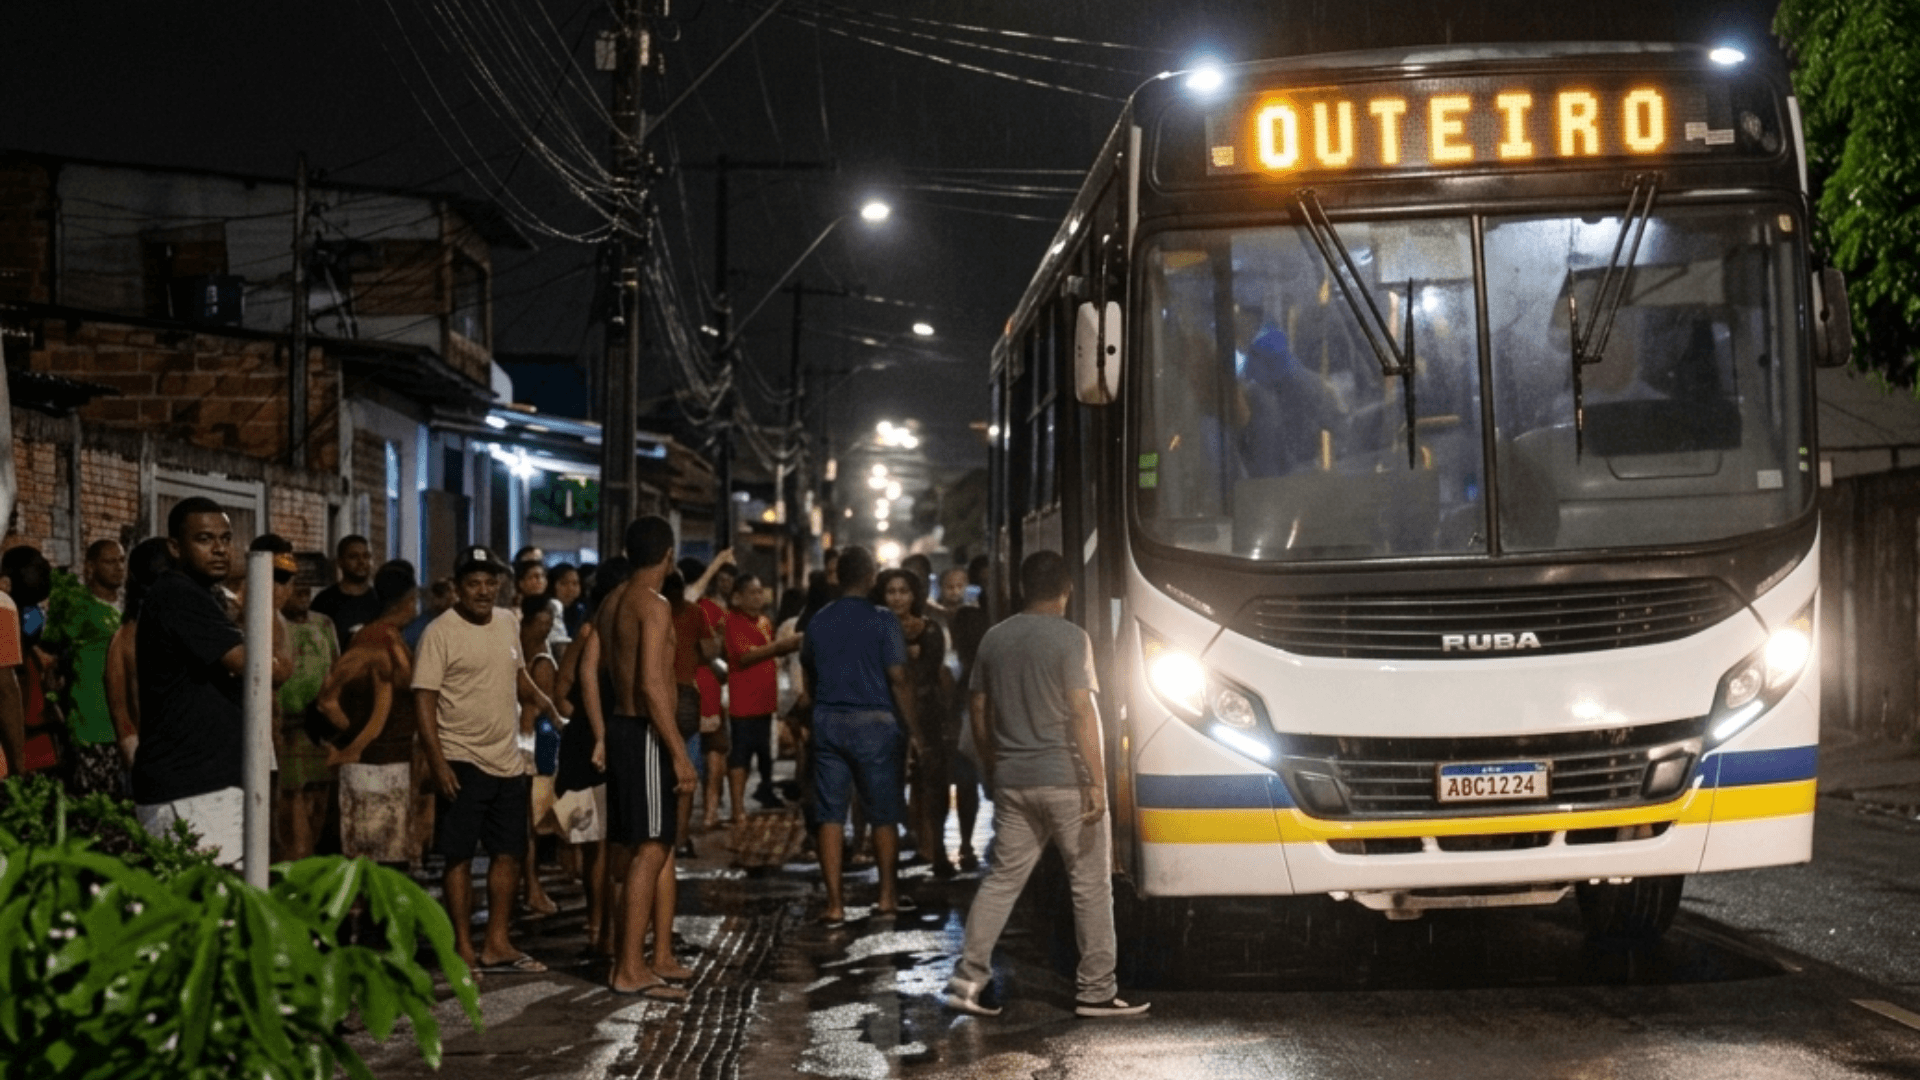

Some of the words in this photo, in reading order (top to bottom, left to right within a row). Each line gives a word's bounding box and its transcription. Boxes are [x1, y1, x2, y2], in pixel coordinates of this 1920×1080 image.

[1257, 89, 1665, 169] OUTEIRO
[1442, 632, 1541, 651] RUBA
[1447, 775, 1535, 796] ABC1224
